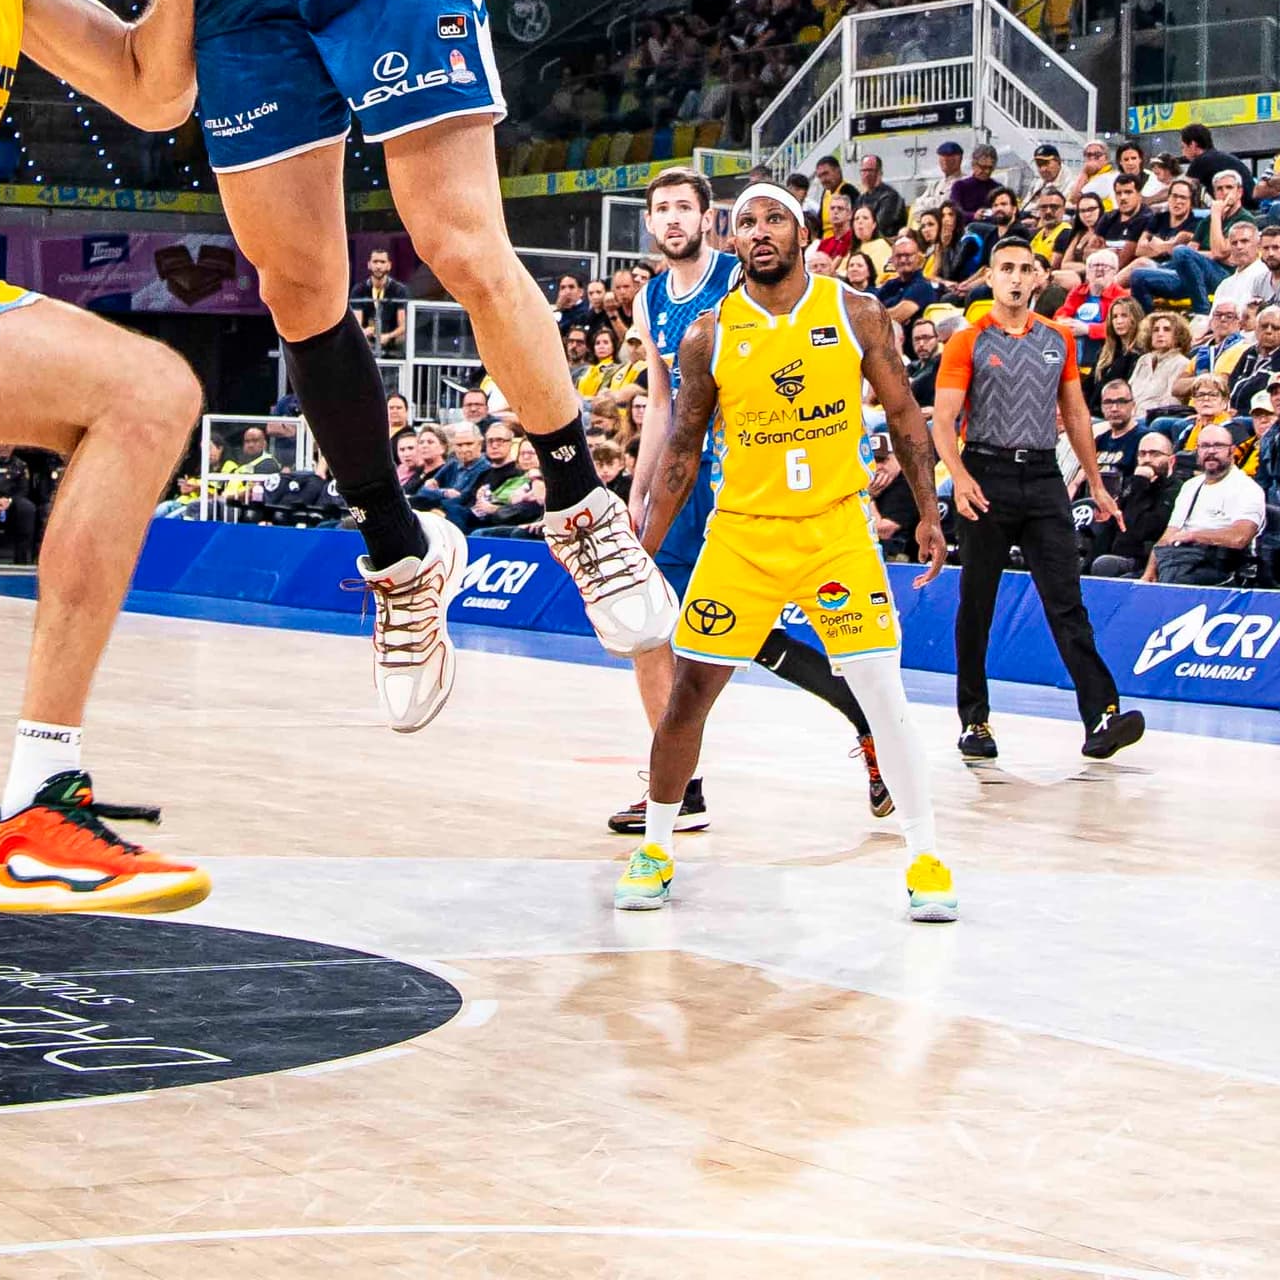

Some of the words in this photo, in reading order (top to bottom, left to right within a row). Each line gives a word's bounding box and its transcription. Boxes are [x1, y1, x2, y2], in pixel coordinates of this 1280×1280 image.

[440, 24, 461, 35] acb
[347, 69, 449, 111] LEXUS
[234, 112, 244, 126] Y
[247, 102, 278, 120] LEÓN
[735, 399, 846, 427] DREAMLAND
[754, 419, 848, 445] GranCanaria
[785, 448, 812, 492] 6
[820, 612, 863, 626] Poema
[840, 624, 863, 635] Mar
[1175, 662, 1256, 681] CANARIAS
